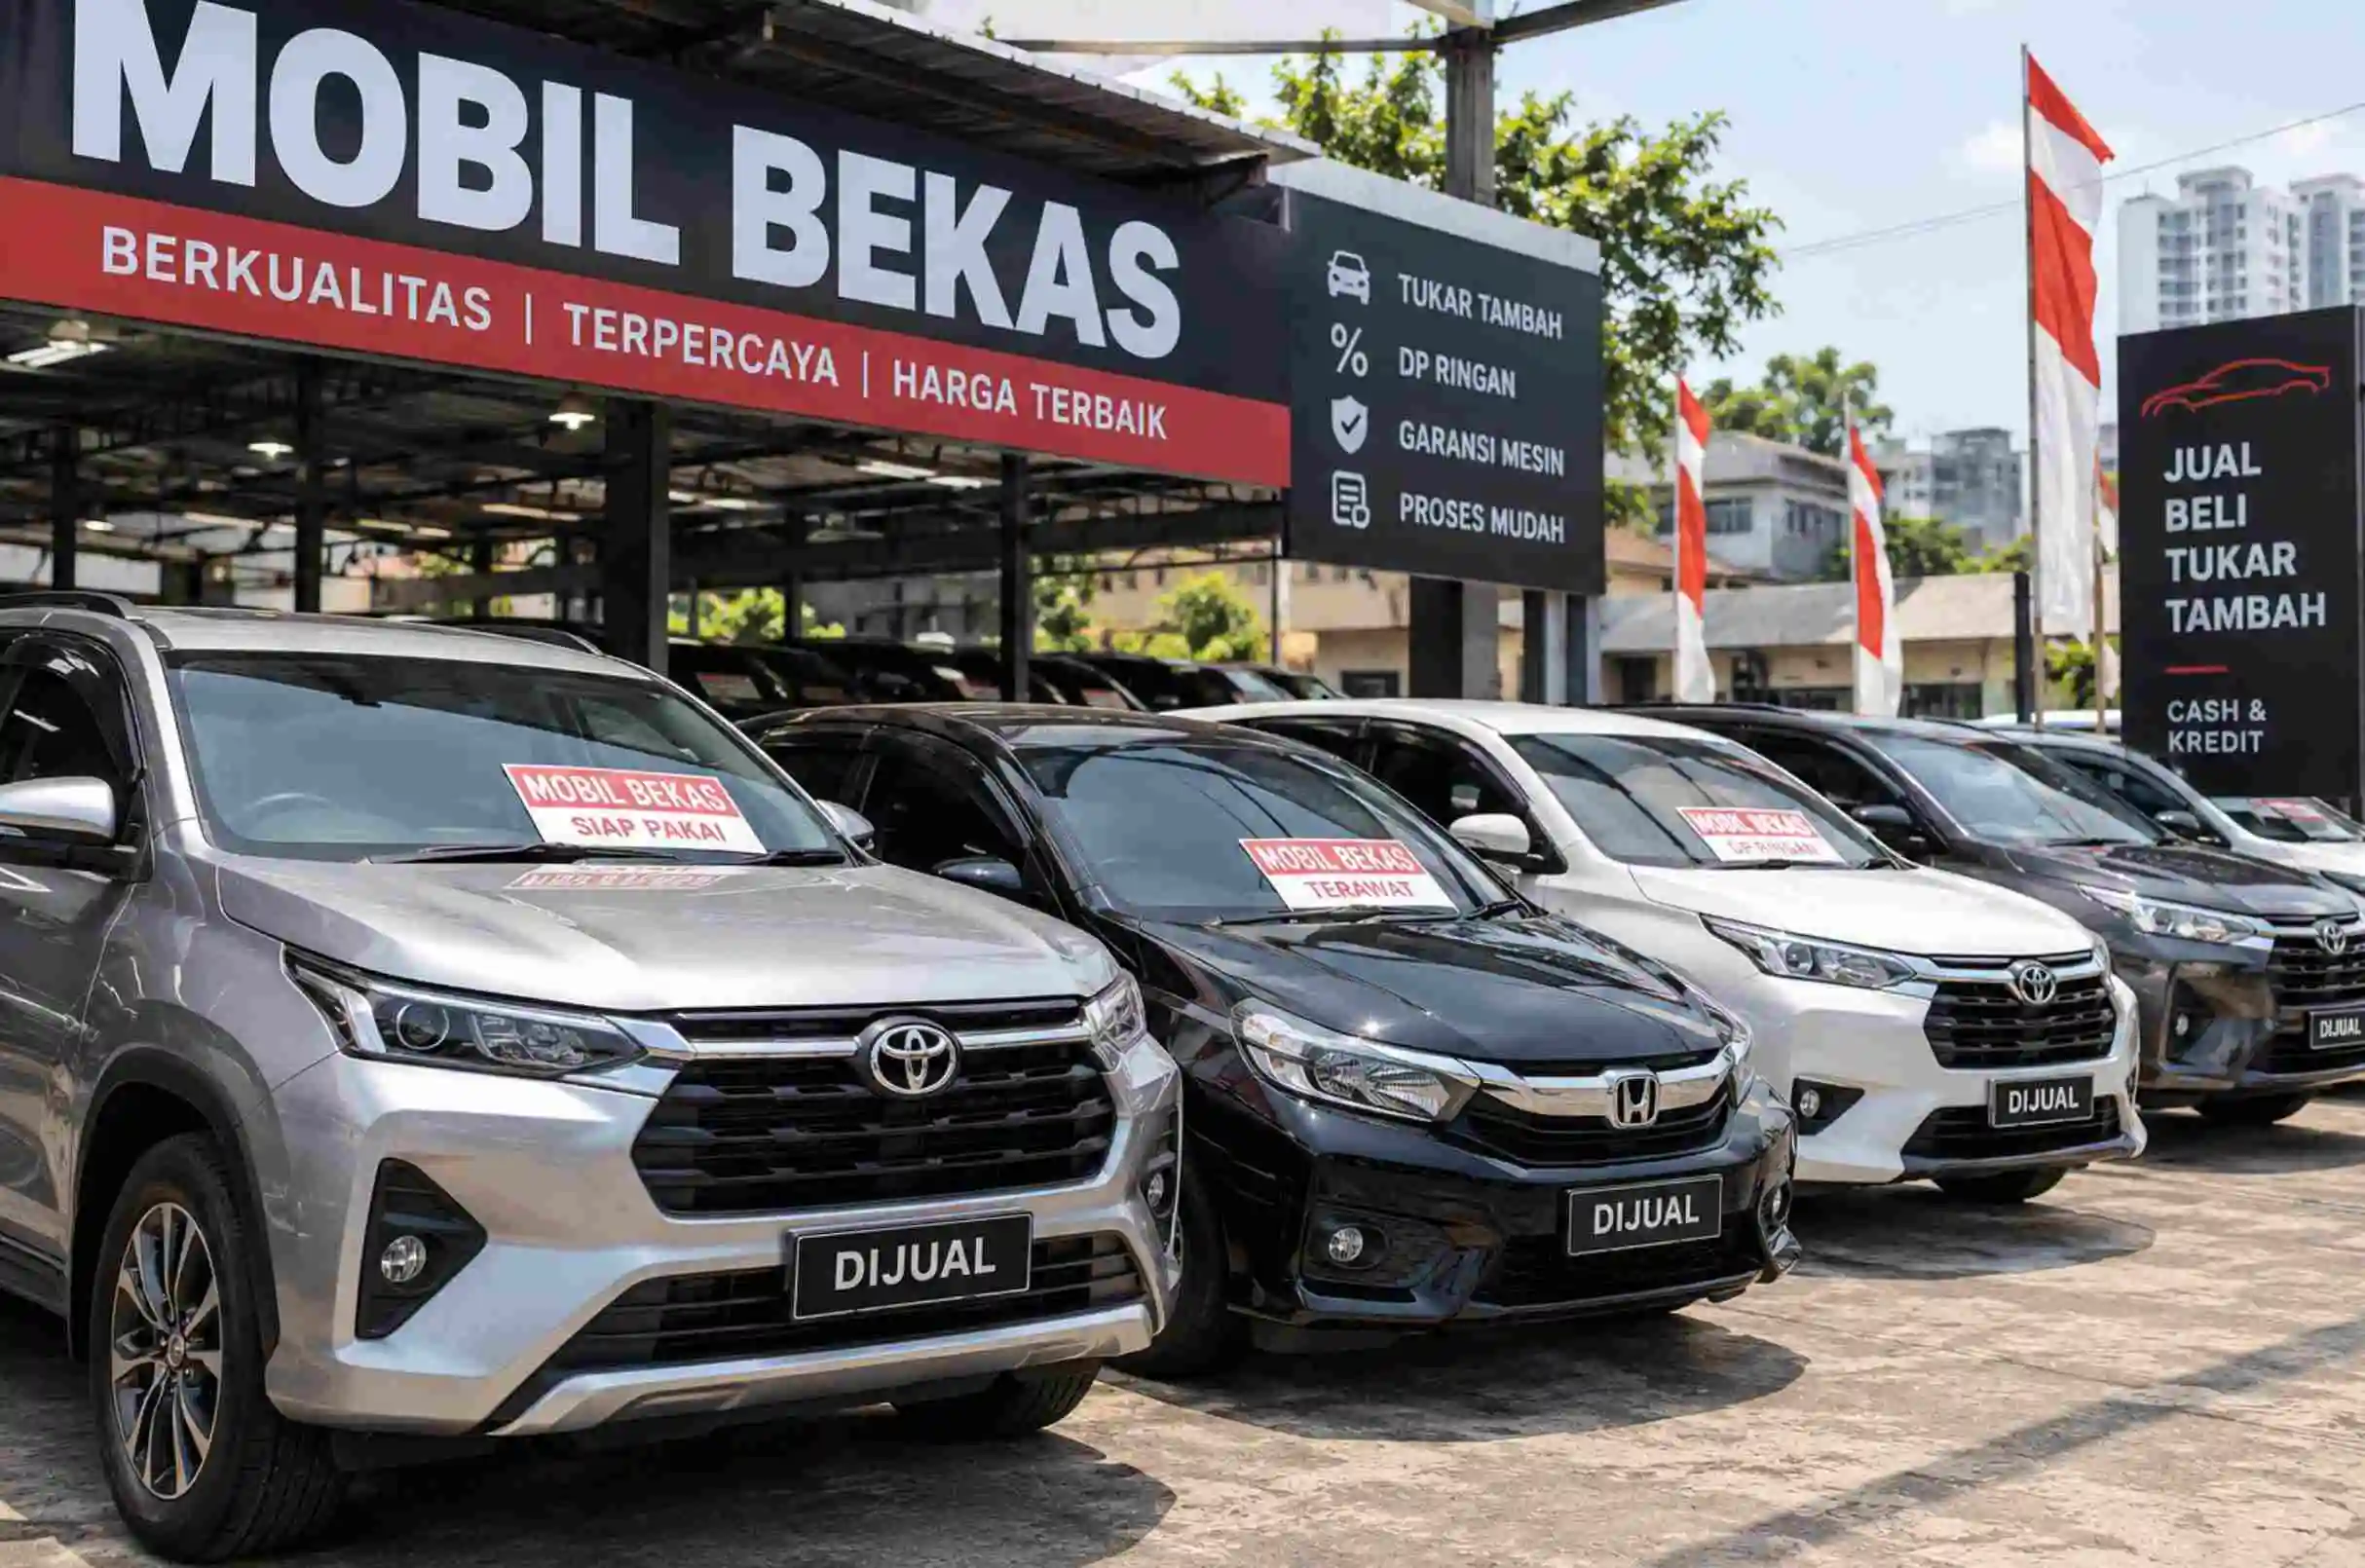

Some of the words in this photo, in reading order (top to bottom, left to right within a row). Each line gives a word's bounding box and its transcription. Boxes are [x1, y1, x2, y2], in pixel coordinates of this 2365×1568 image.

[72, 0, 680, 265] MOBIL
[732, 125, 1181, 358] BEKAS
[1398, 273, 1472, 319] TUKAR
[1478, 293, 1562, 340] TAMBAH
[101, 225, 492, 330] BERKUALITAS
[563, 302, 839, 387] TERPERCAYA
[893, 360, 1017, 417] HARGA
[1030, 383, 1168, 440] TERBAIK
[1399, 346, 1429, 380] DP
[1436, 354, 1517, 398] RINGAN
[1399, 421, 1495, 465] GARANSI
[1502, 438, 1564, 477] MESIN
[2163, 442, 2262, 483] JUAL
[1400, 492, 1485, 532] PROSES
[1491, 506, 1564, 544] MUDAH
[2165, 494, 2246, 533] BELI
[2165, 541, 2297, 582] TUKAR
[2165, 592, 2327, 633] TAMBAH
[2167, 700, 2239, 724] CASH
[2249, 698, 2268, 722] &
[2168, 730, 2265, 754] KREDIT
[522, 775, 625, 805] MOBIL
[626, 778, 728, 812] BEKAS
[571, 816, 635, 838] SIAP
[643, 819, 728, 842] PAKAI
[1256, 845, 1337, 871] MOBIL
[1334, 845, 1415, 872] BEKAS
[1303, 880, 1415, 899] TERAWAT
[2319, 1017, 2362, 1039] DIJUAL
[2008, 1085, 2080, 1114] DIJUAL
[1593, 1194, 1700, 1235] DIJUAL
[834, 1237, 996, 1290] DIJUAL
